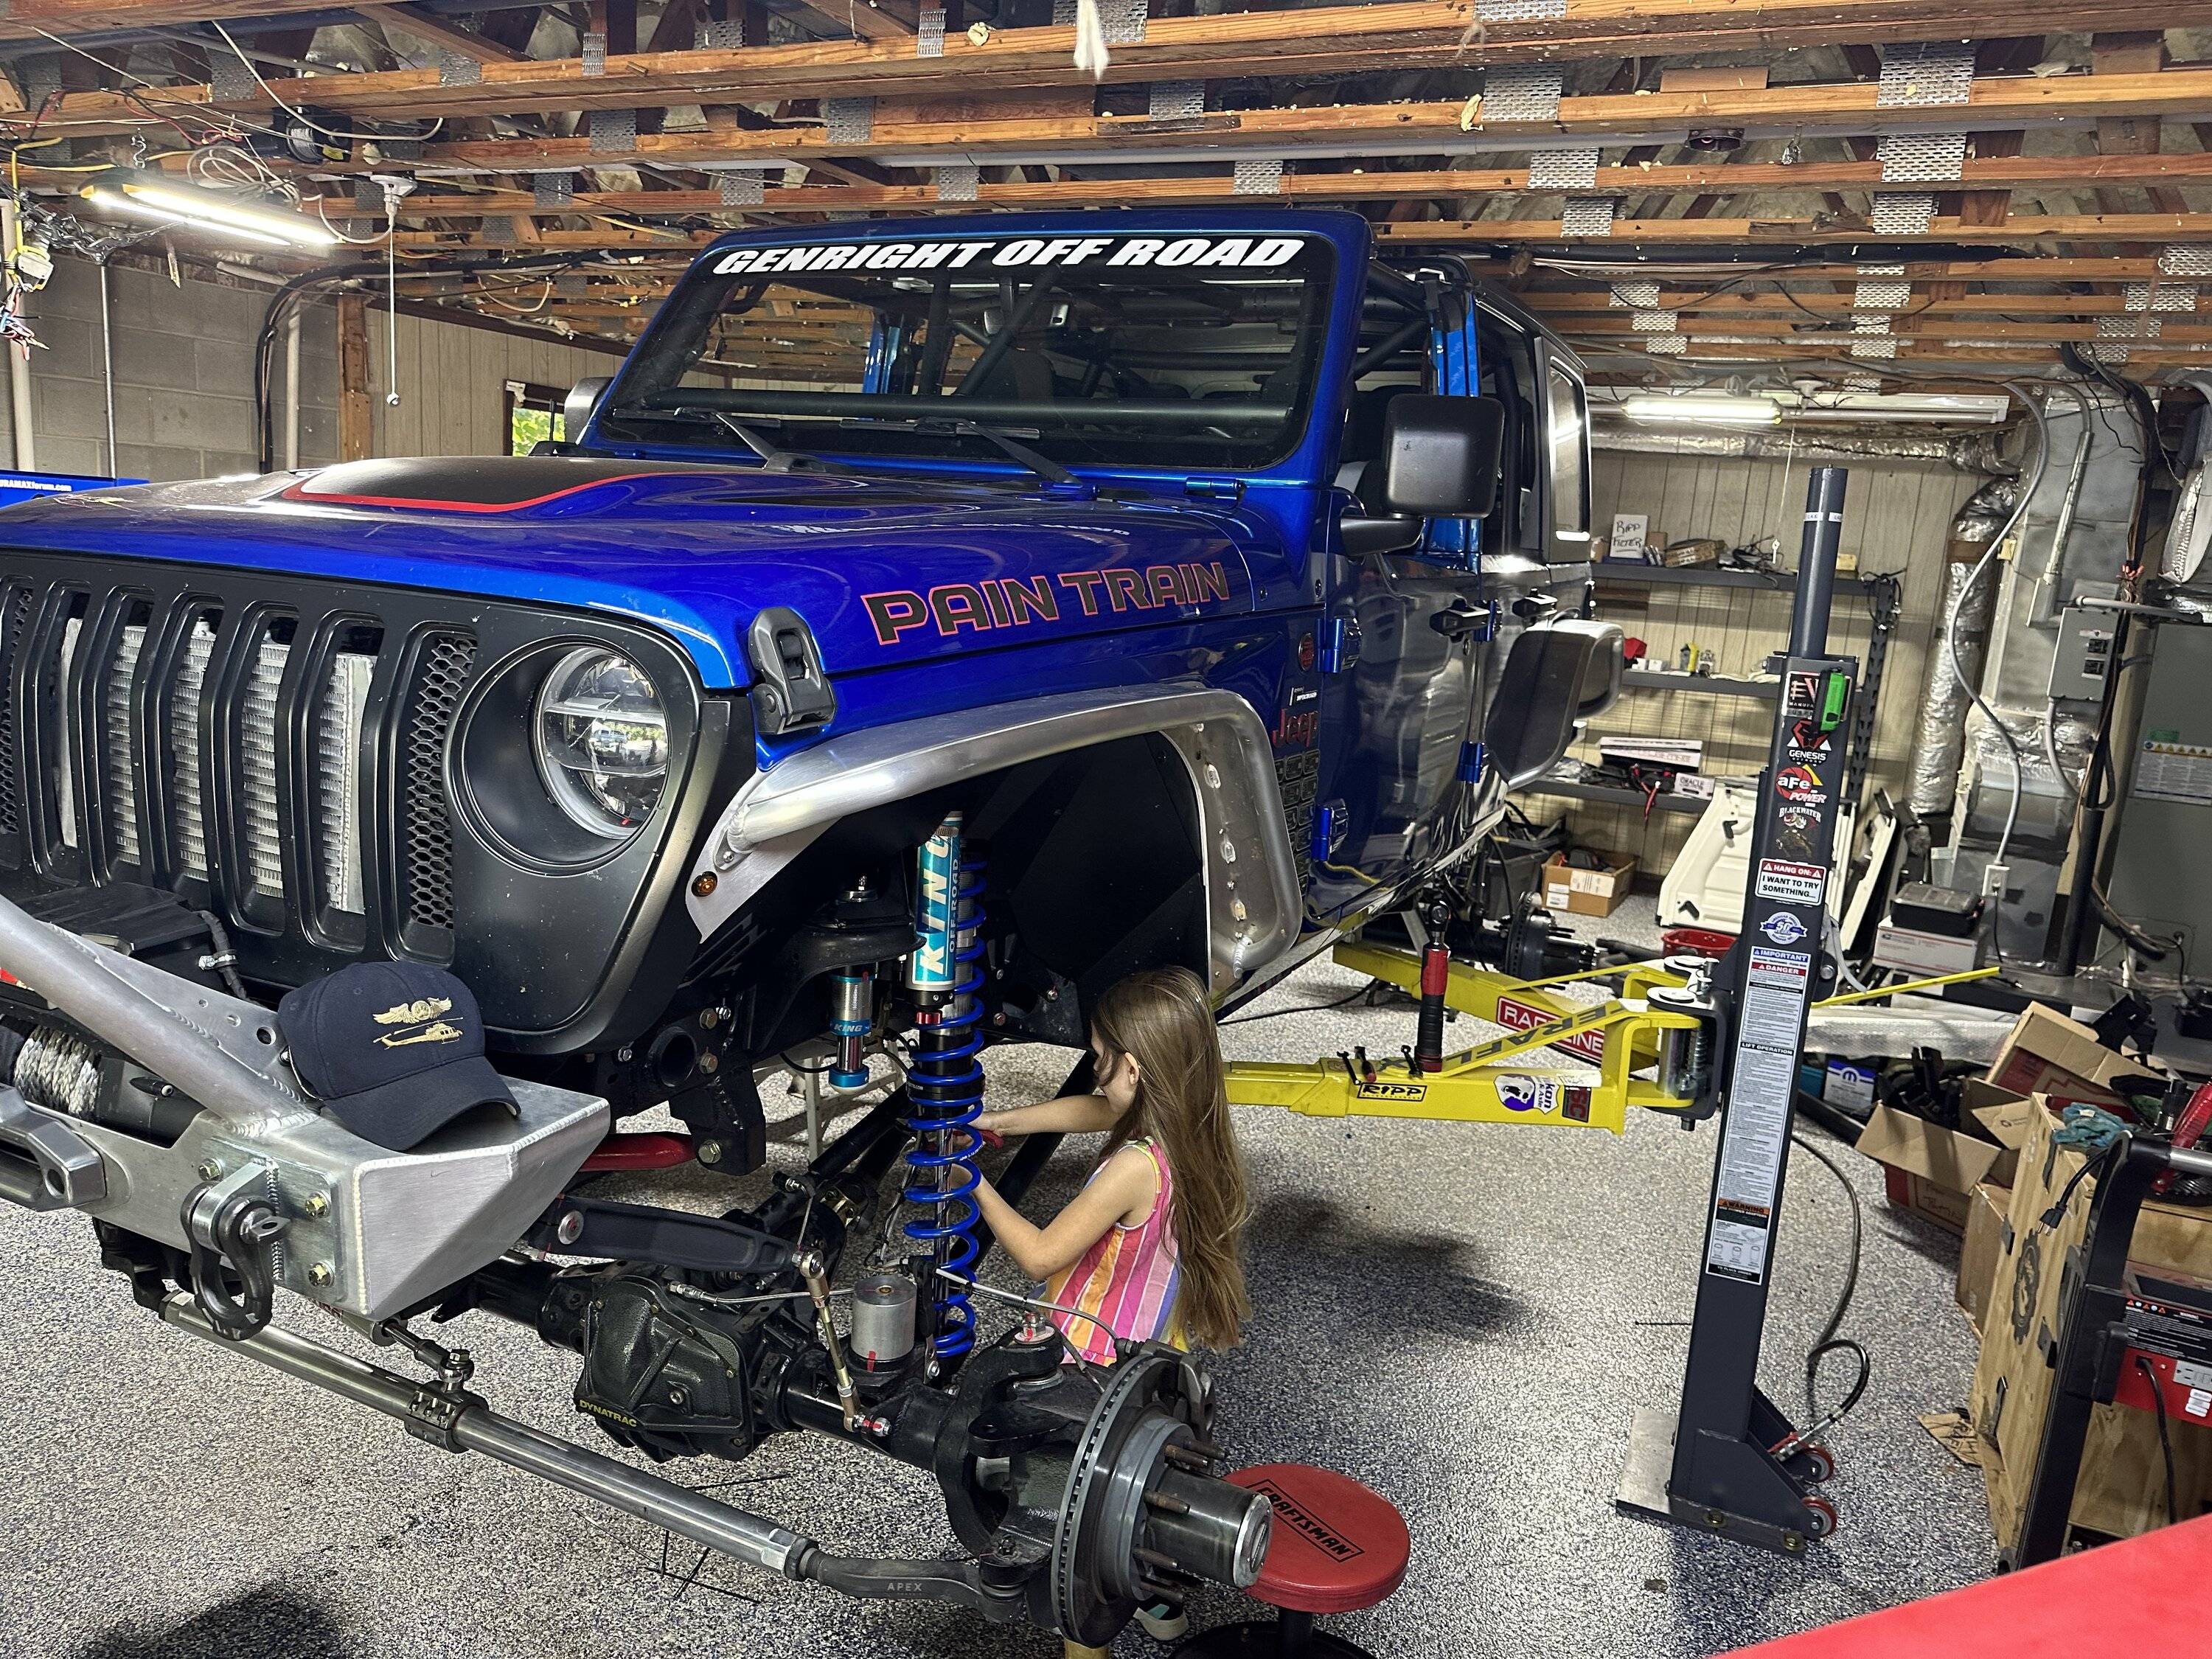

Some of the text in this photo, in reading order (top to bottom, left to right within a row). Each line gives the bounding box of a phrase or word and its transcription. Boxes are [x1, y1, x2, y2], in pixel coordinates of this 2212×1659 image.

[713, 239, 1305, 274] GENRIGHT OFF ROAD
[860, 563, 1231, 645] PAIN TRAIN
[1789, 749, 1826, 761] GENESIS
[1778, 776, 1810, 789] aFe
[1789, 792, 1827, 804] POWER
[1778, 807, 1821, 823] BLACKWATER
[1773, 864, 1796, 874] HANG
[1767, 876, 1790, 885] WANT
[1804, 881, 1819, 889] TRY
[1760, 950, 1807, 961] IMPORTANT
[1765, 964, 1799, 975] DANGER
[834, 1023, 863, 1032] KING
[1756, 1044, 1792, 1055] OPERATION
[1363, 1084, 1422, 1096] RIPP
[1545, 1084, 1555, 1109] kon
[580, 1399, 637, 1427] DYNATRAC
[887, 1582, 922, 1592] APEX
